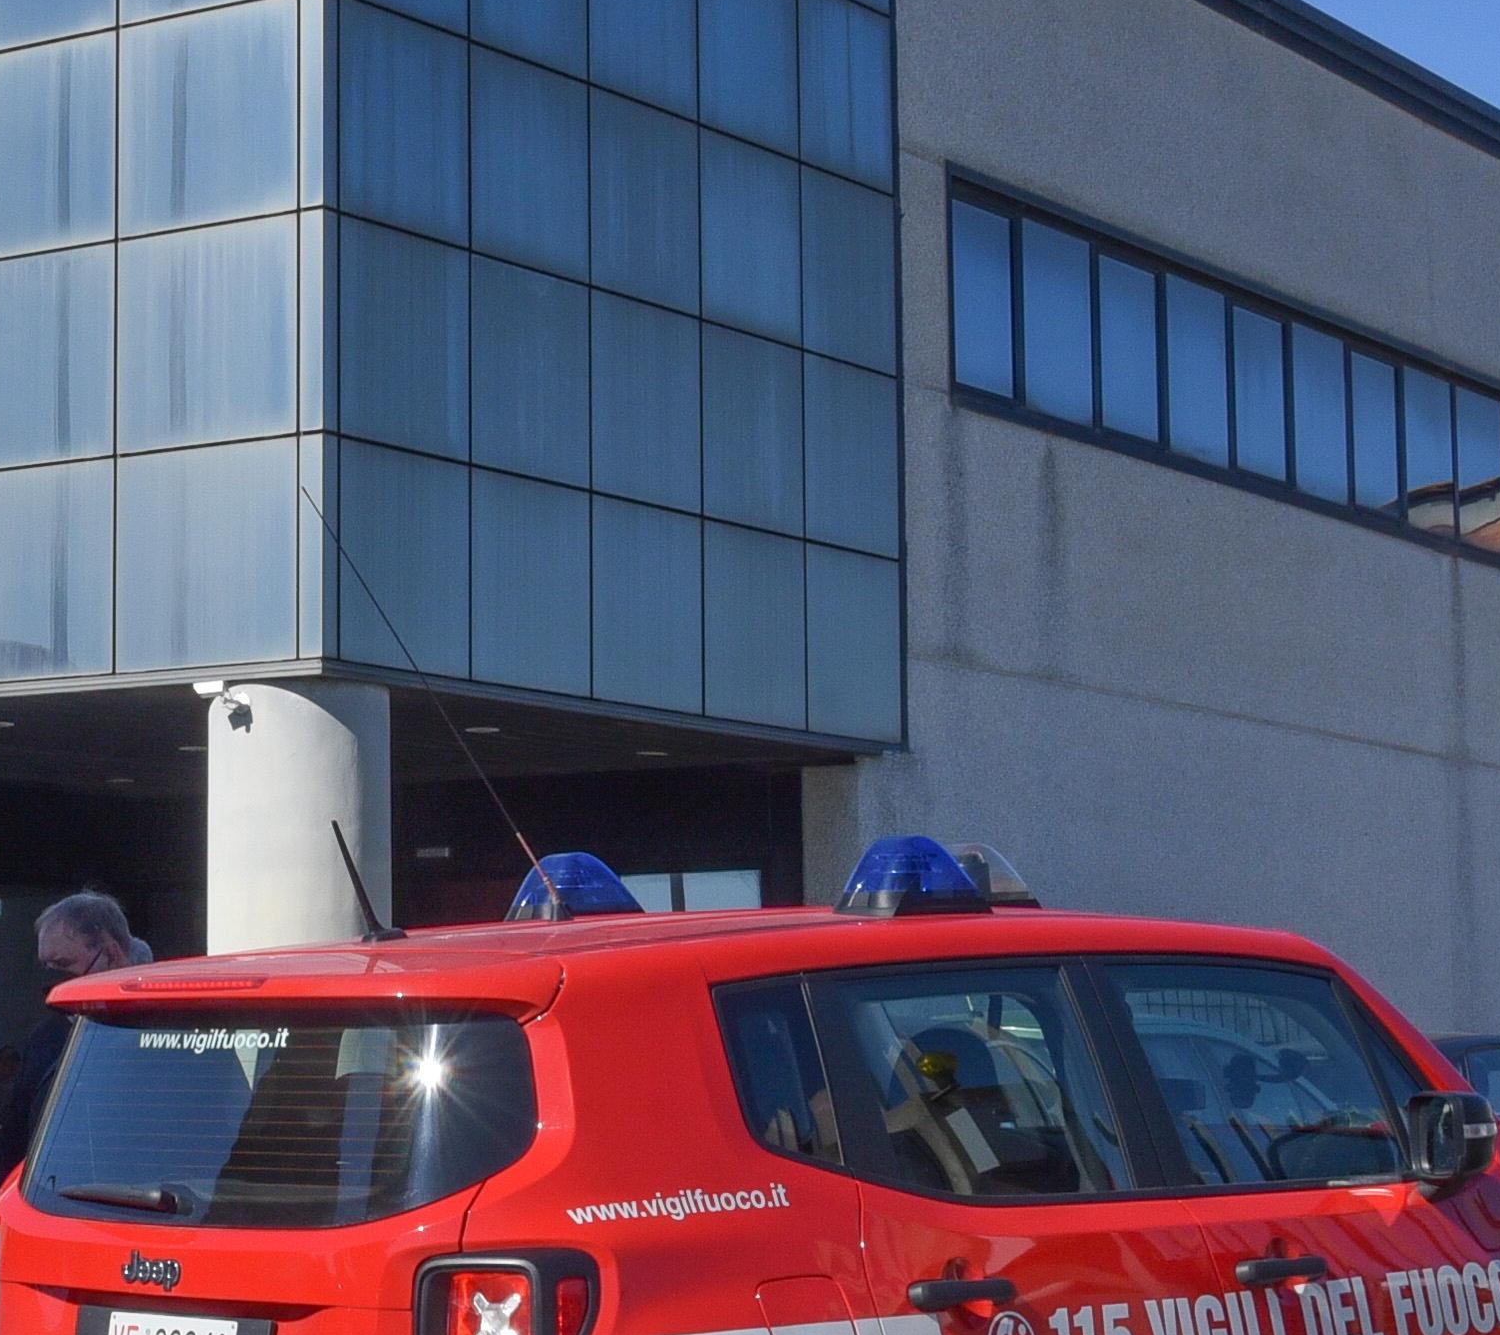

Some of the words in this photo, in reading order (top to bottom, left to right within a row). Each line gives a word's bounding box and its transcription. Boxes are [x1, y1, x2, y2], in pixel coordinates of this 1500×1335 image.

[139, 1028, 290, 1054] www.vigilfuoco.it
[566, 1182, 790, 1225] www.vigilfuoco.it
[122, 1249, 181, 1292] Jeep
